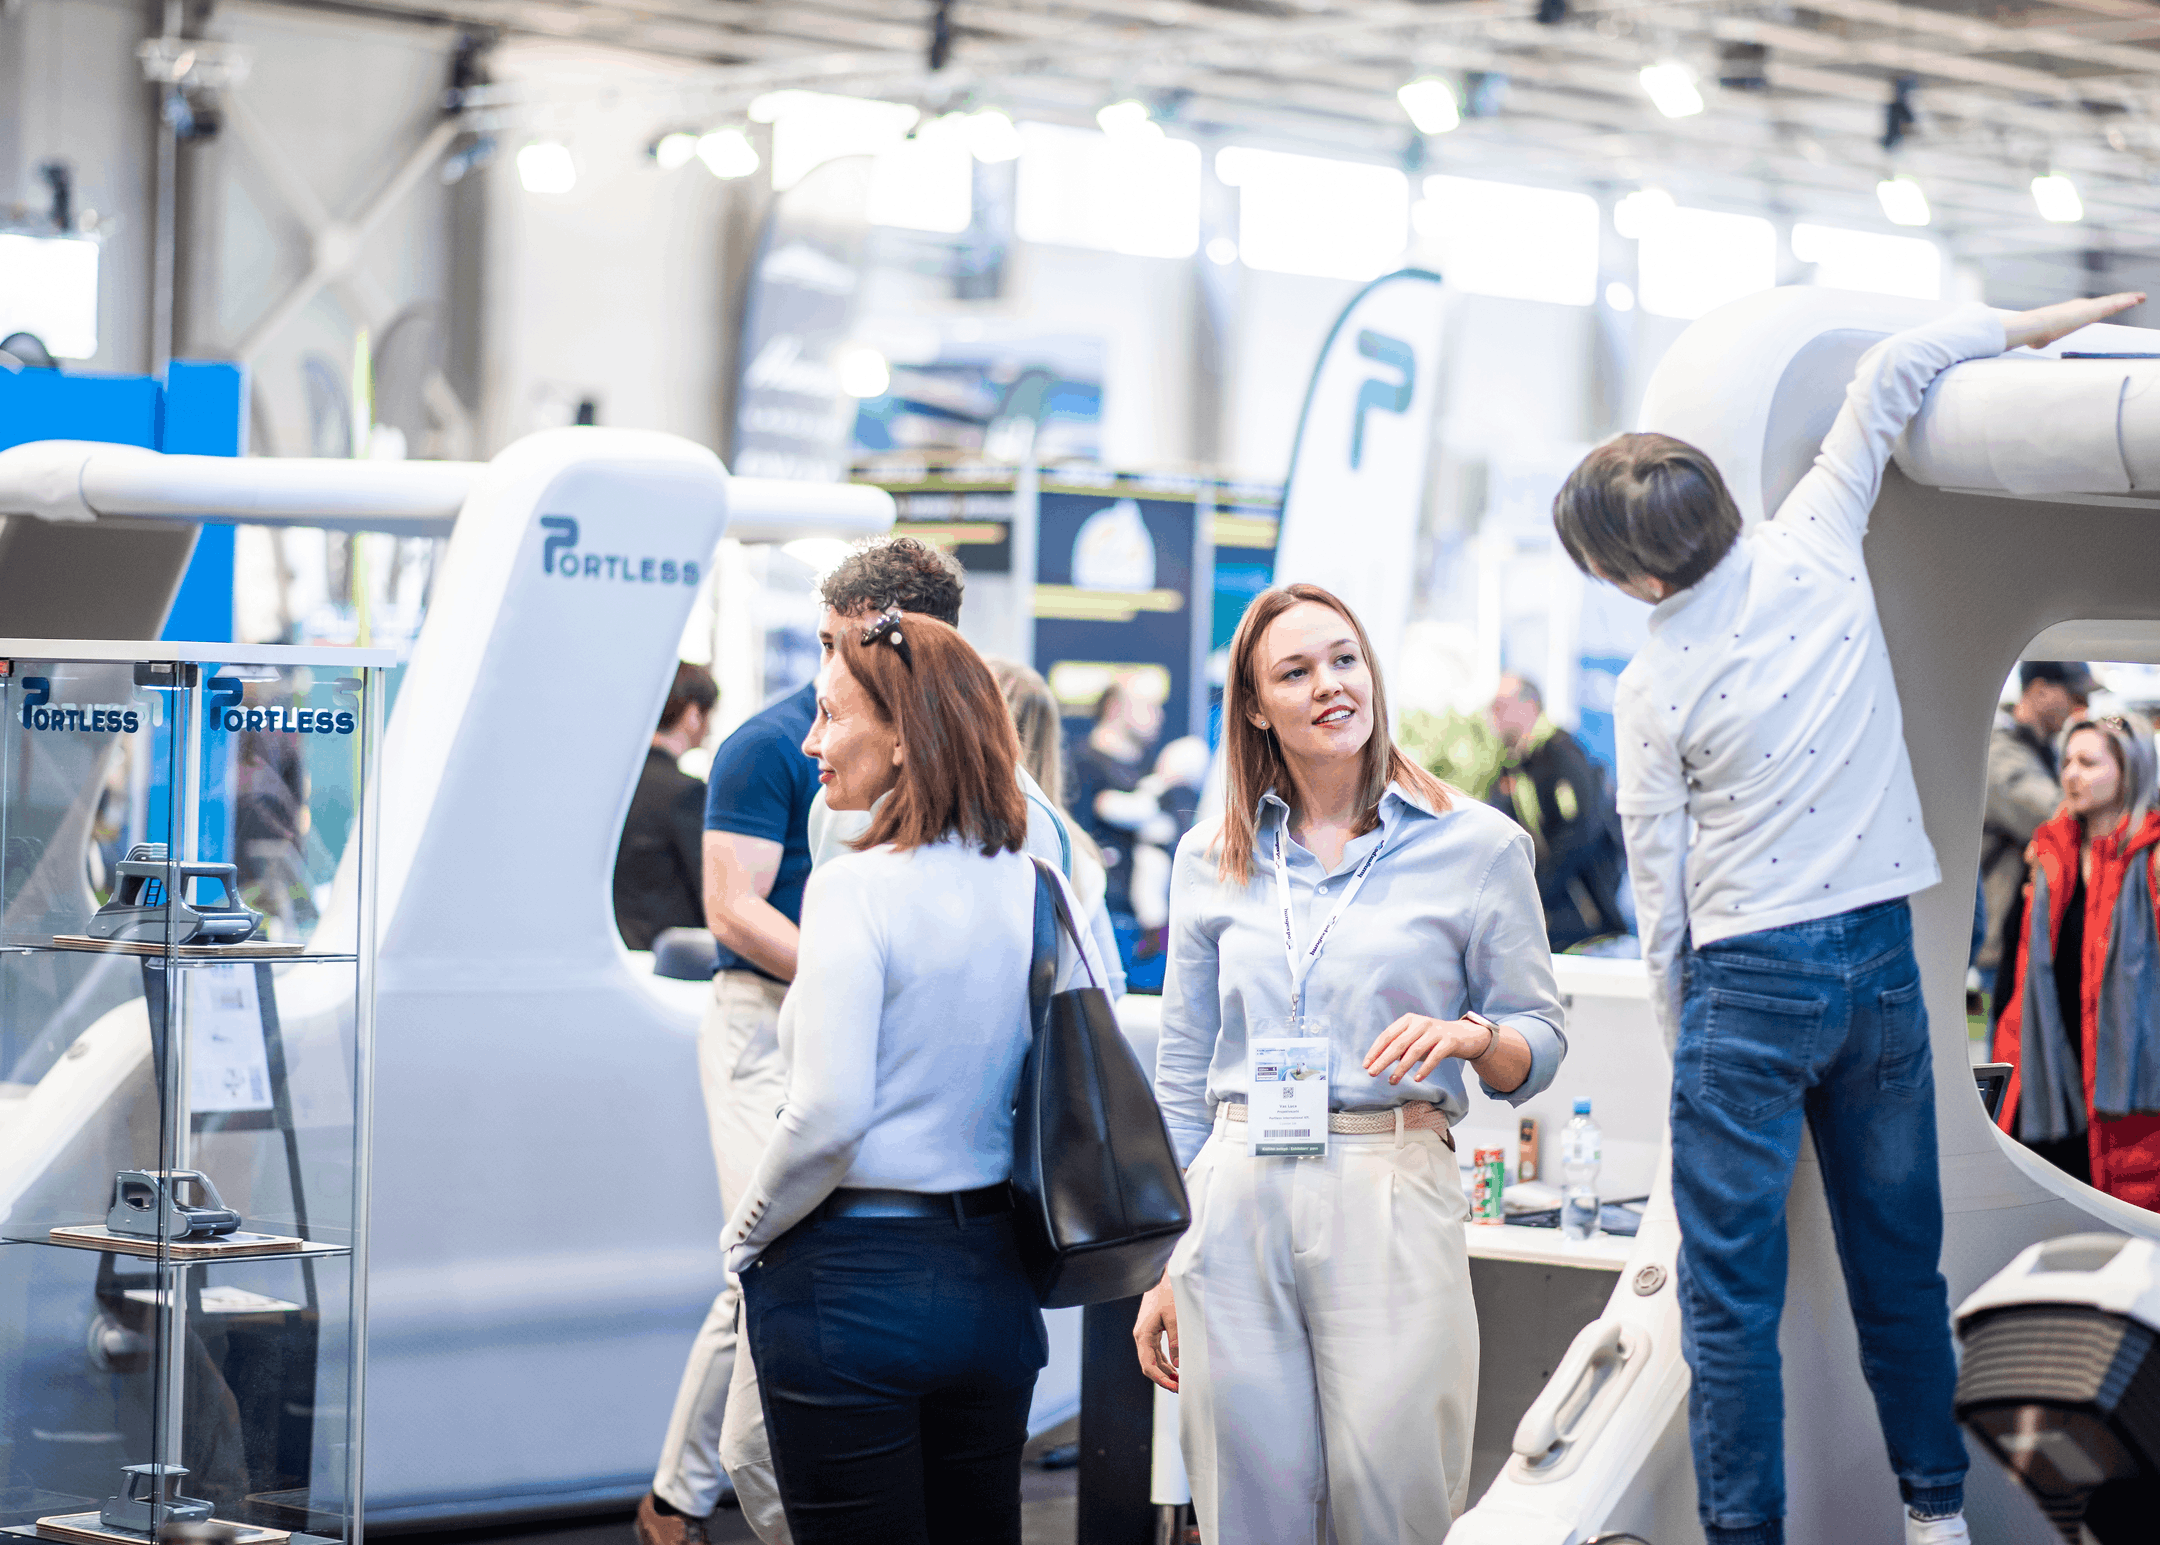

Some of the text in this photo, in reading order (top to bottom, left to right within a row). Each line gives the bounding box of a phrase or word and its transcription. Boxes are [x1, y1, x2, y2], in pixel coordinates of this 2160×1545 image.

[540, 515, 699, 586] PORTLESS
[21, 677, 139, 733] PORTLESS
[207, 677, 355, 734] PORTLESS
[1284, 908, 1292, 940] hungexpo
